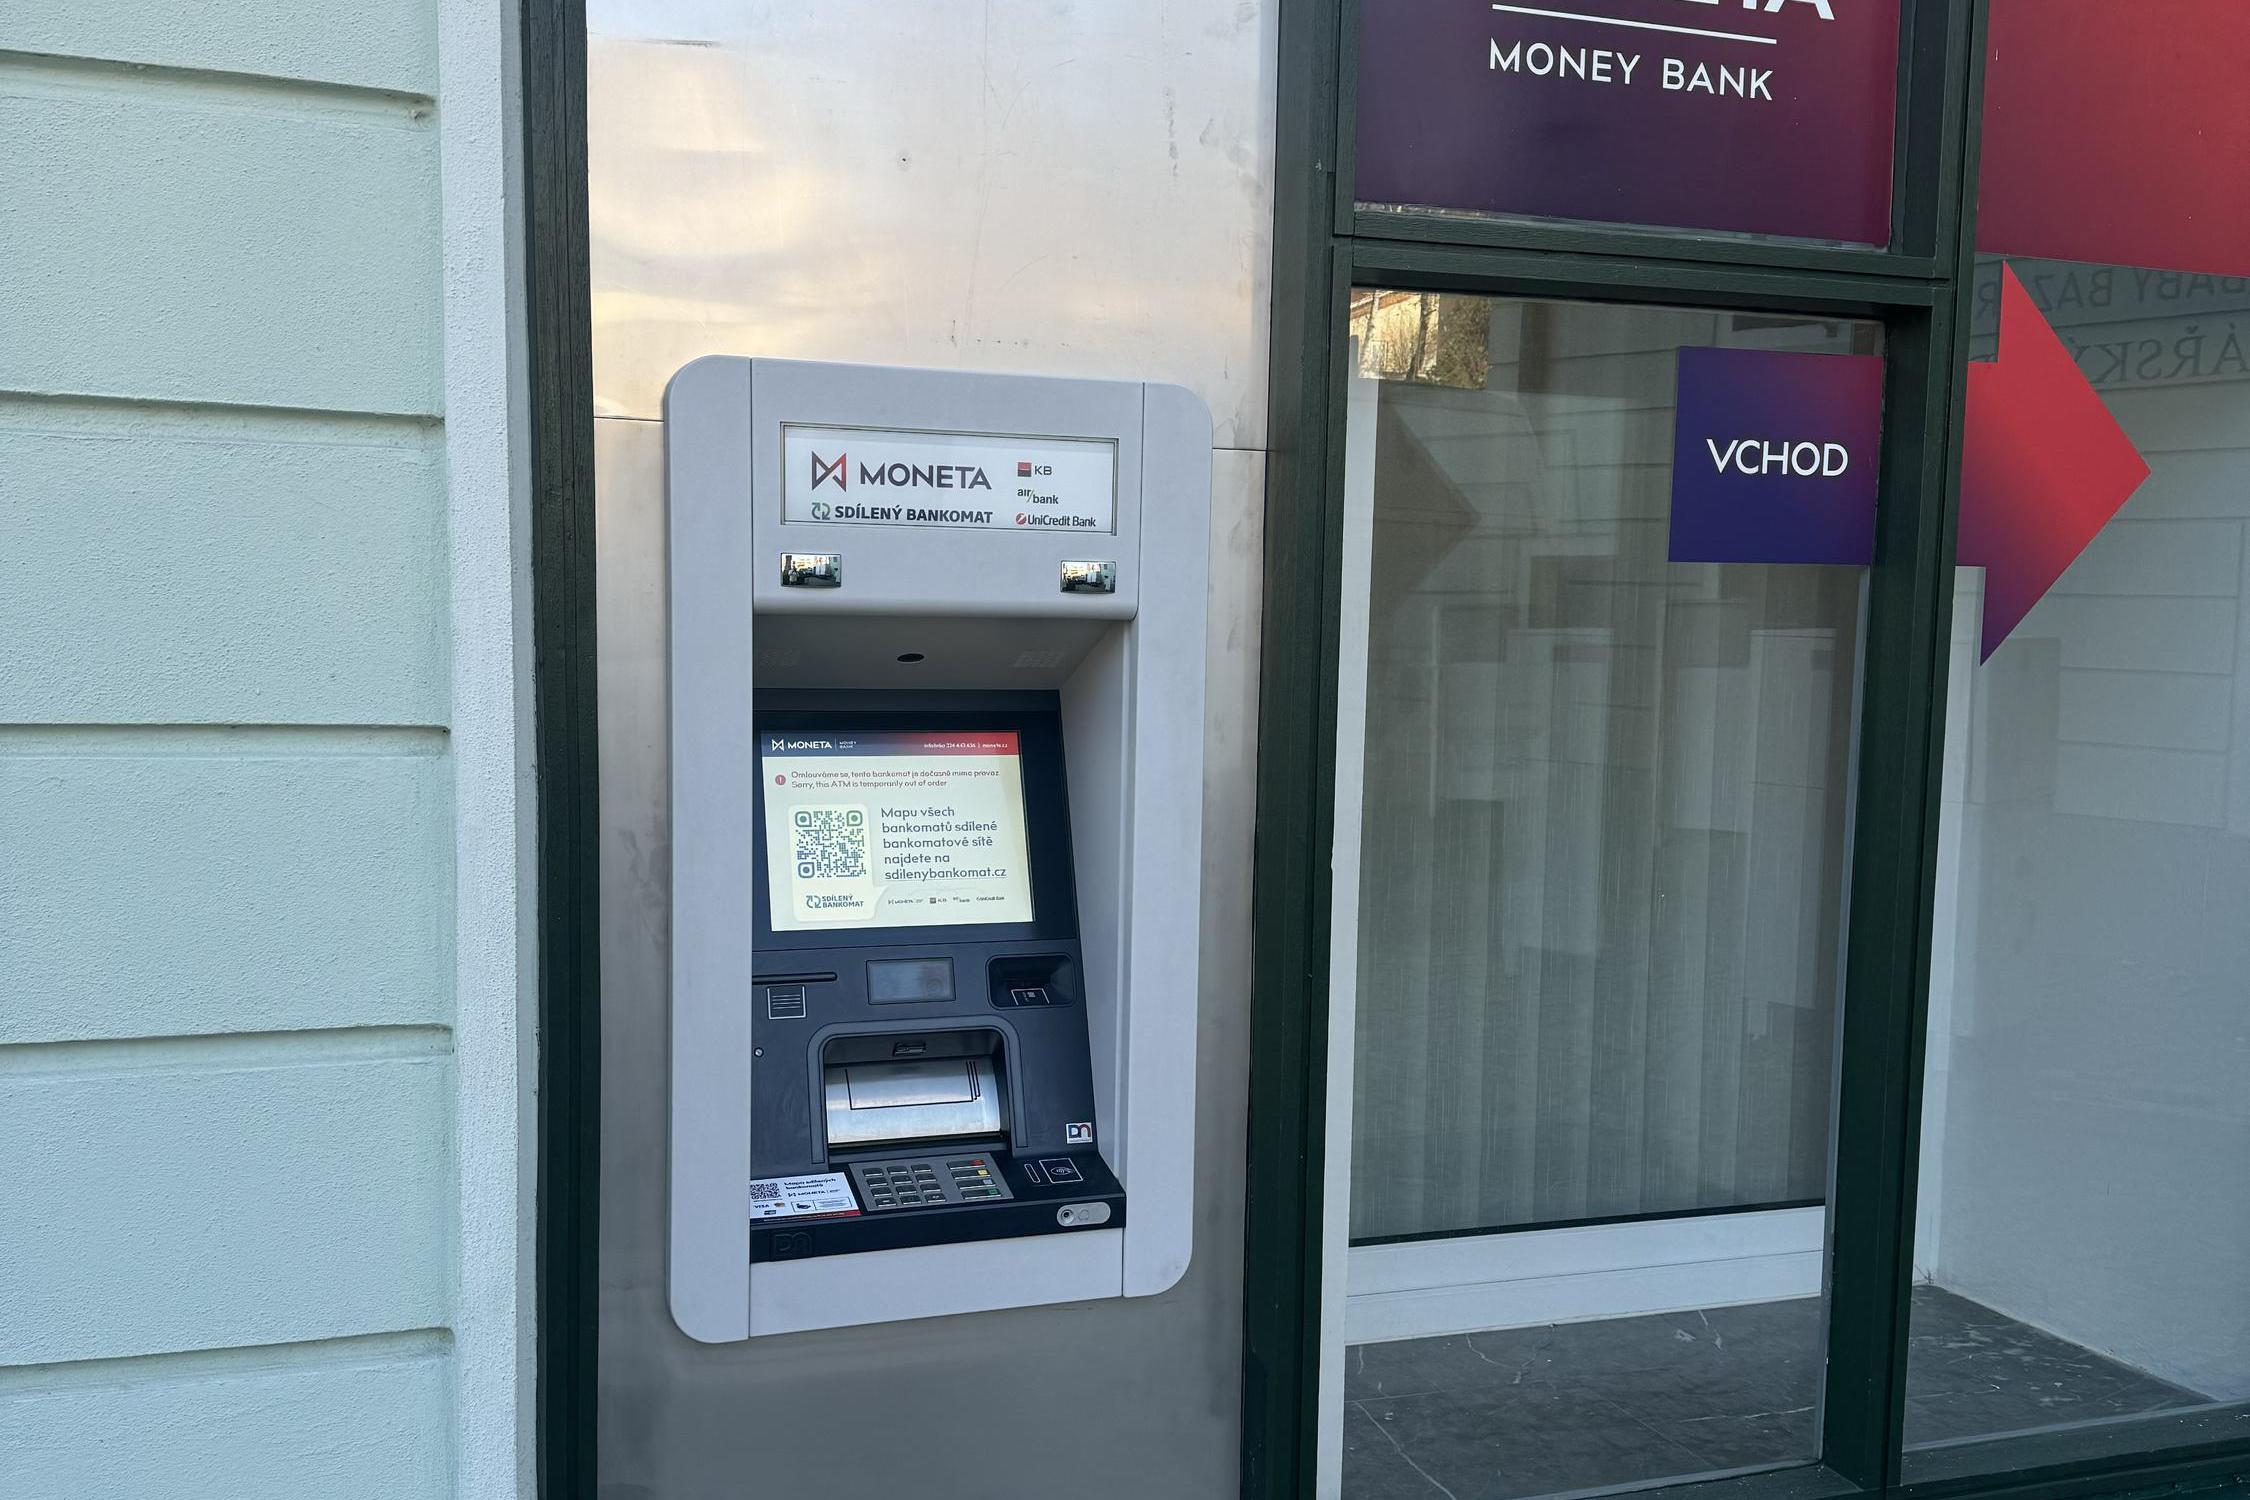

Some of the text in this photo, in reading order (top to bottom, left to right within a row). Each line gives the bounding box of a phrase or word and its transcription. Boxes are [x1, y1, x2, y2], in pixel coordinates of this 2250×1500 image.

[1489, 38, 1774, 101] MONEY BANK
[1705, 437, 1850, 478] VCHOD
[860, 461, 992, 490] MONETA
[1034, 465, 1053, 476] KB
[1032, 494, 1059, 505] bank
[834, 503, 993, 524] SDÍLENÝ BANKOMAT
[1027, 513, 1097, 528] UniCredit Bank
[787, 740, 833, 749] MONETA
[872, 769, 910, 778] bankomat
[830, 780, 851, 788] ATM
[859, 779, 903, 789] temporarily
[904, 779, 917, 787] out
[918, 779, 926, 787] of
[927, 778, 947, 787] order
[881, 806, 955, 820] Mapu všech
[882, 820, 998, 833] bankomatů sdílené
[883, 836, 993, 848] bankomatové sítě
[884, 853, 950, 867] najdete na
[884, 866, 1007, 882] sdilenybankomat.cz
[821, 893, 854, 902] SDÍLENÝ
[822, 900, 865, 909] BANKOMAT
